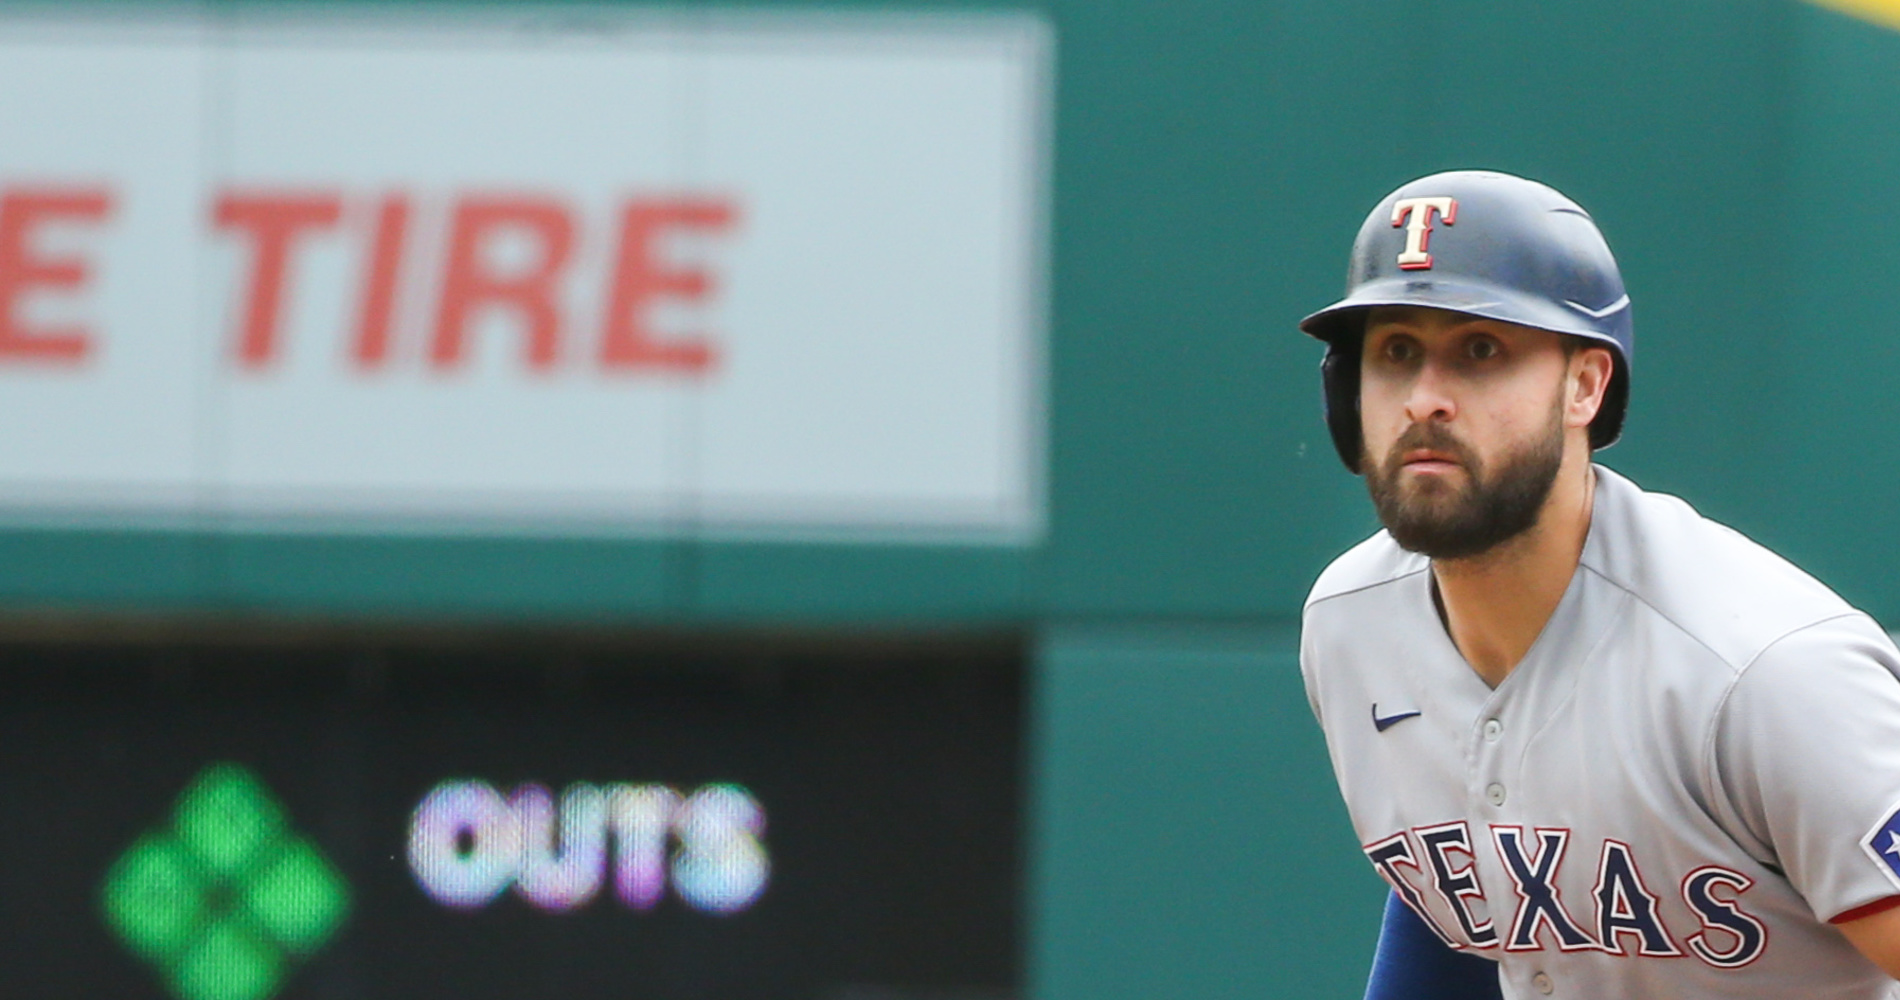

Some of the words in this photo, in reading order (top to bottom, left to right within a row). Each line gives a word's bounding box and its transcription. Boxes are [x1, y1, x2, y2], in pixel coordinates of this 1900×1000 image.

[210, 188, 740, 374] TIRE
[1391, 196, 1457, 270] T
[408, 780, 769, 912] OUTS
[1363, 820, 1768, 968] TEXAS
